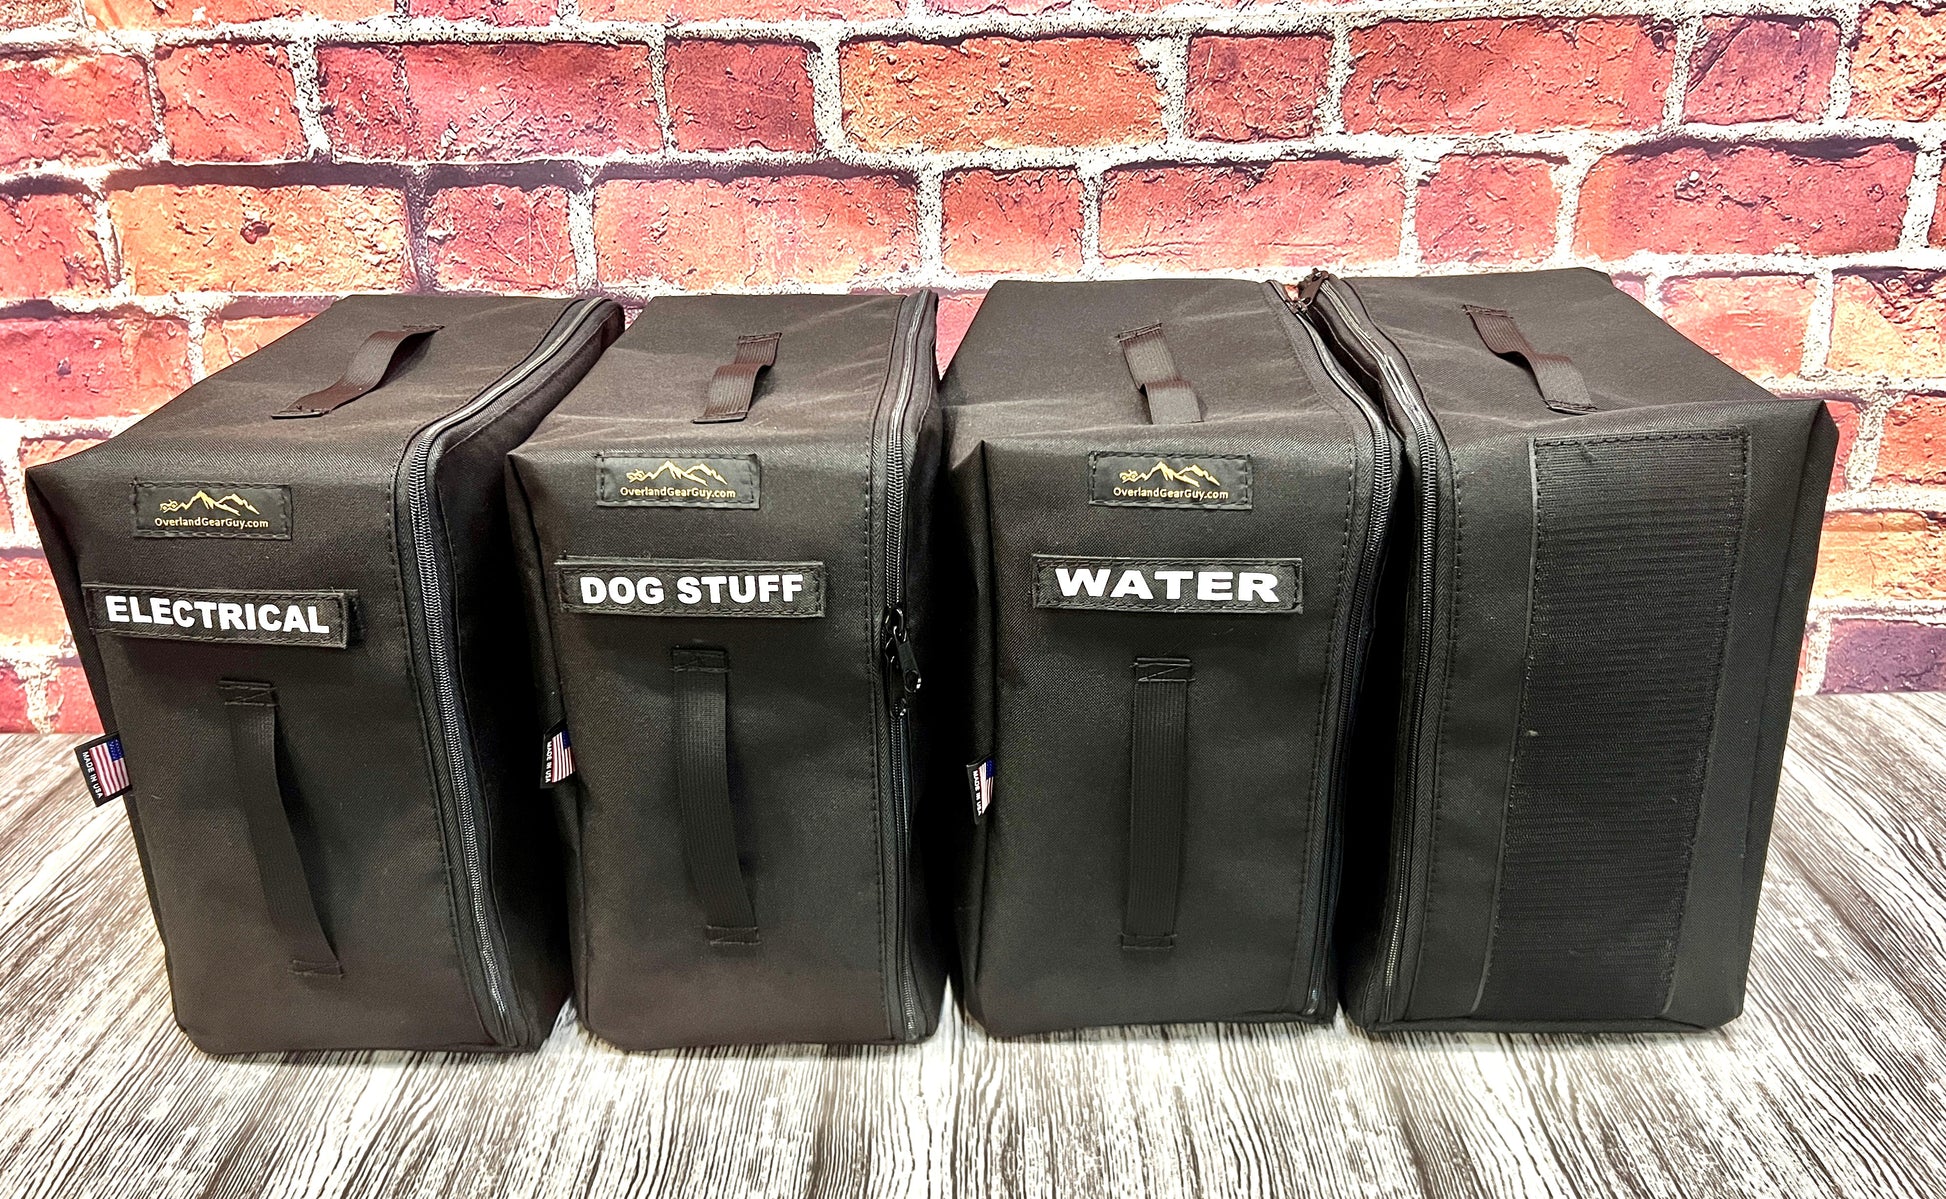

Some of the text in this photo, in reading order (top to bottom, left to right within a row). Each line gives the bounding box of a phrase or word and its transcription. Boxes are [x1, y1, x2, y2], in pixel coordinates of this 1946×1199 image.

[620, 487, 736, 499] OverlandGearGuy.com
[1113, 487, 1229, 501] OverlandGearGuy.com
[154, 517, 269, 529] OverlandGearGuy.com
[579, 574, 804, 605] DOG STUFF
[1055, 568, 1280, 603] WATER
[105, 595, 330, 634] ELECTRICAL
[82, 751, 104, 799] MADE IN USA
